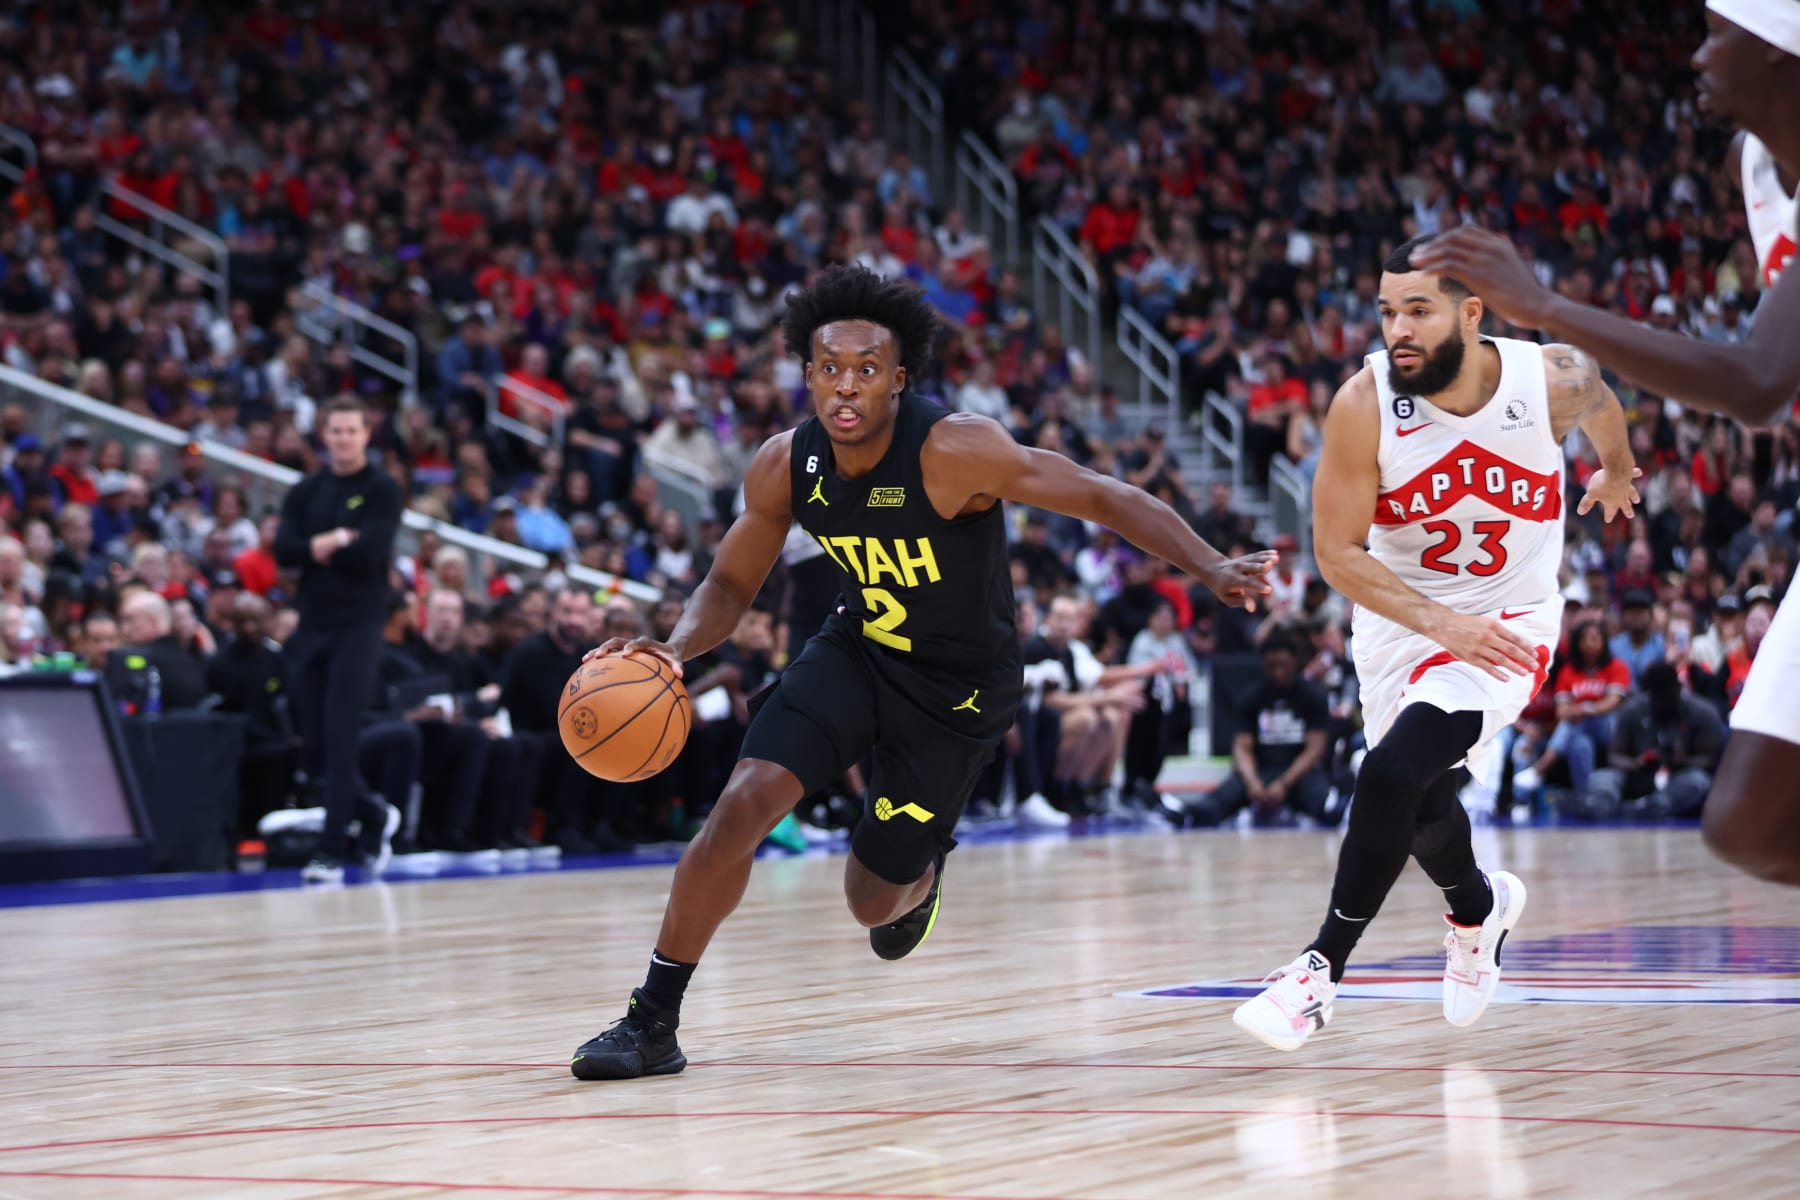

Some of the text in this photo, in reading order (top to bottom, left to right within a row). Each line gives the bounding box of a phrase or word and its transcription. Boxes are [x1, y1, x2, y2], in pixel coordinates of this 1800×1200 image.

[1397, 399, 1411, 417] 6
[1500, 418, 1535, 431] Sun Life
[806, 455, 819, 473] 6
[871, 490, 882, 504] 5
[1388, 457, 1547, 521] RAPTORS
[1420, 519, 1511, 577] 23
[861, 587, 912, 652] 2
